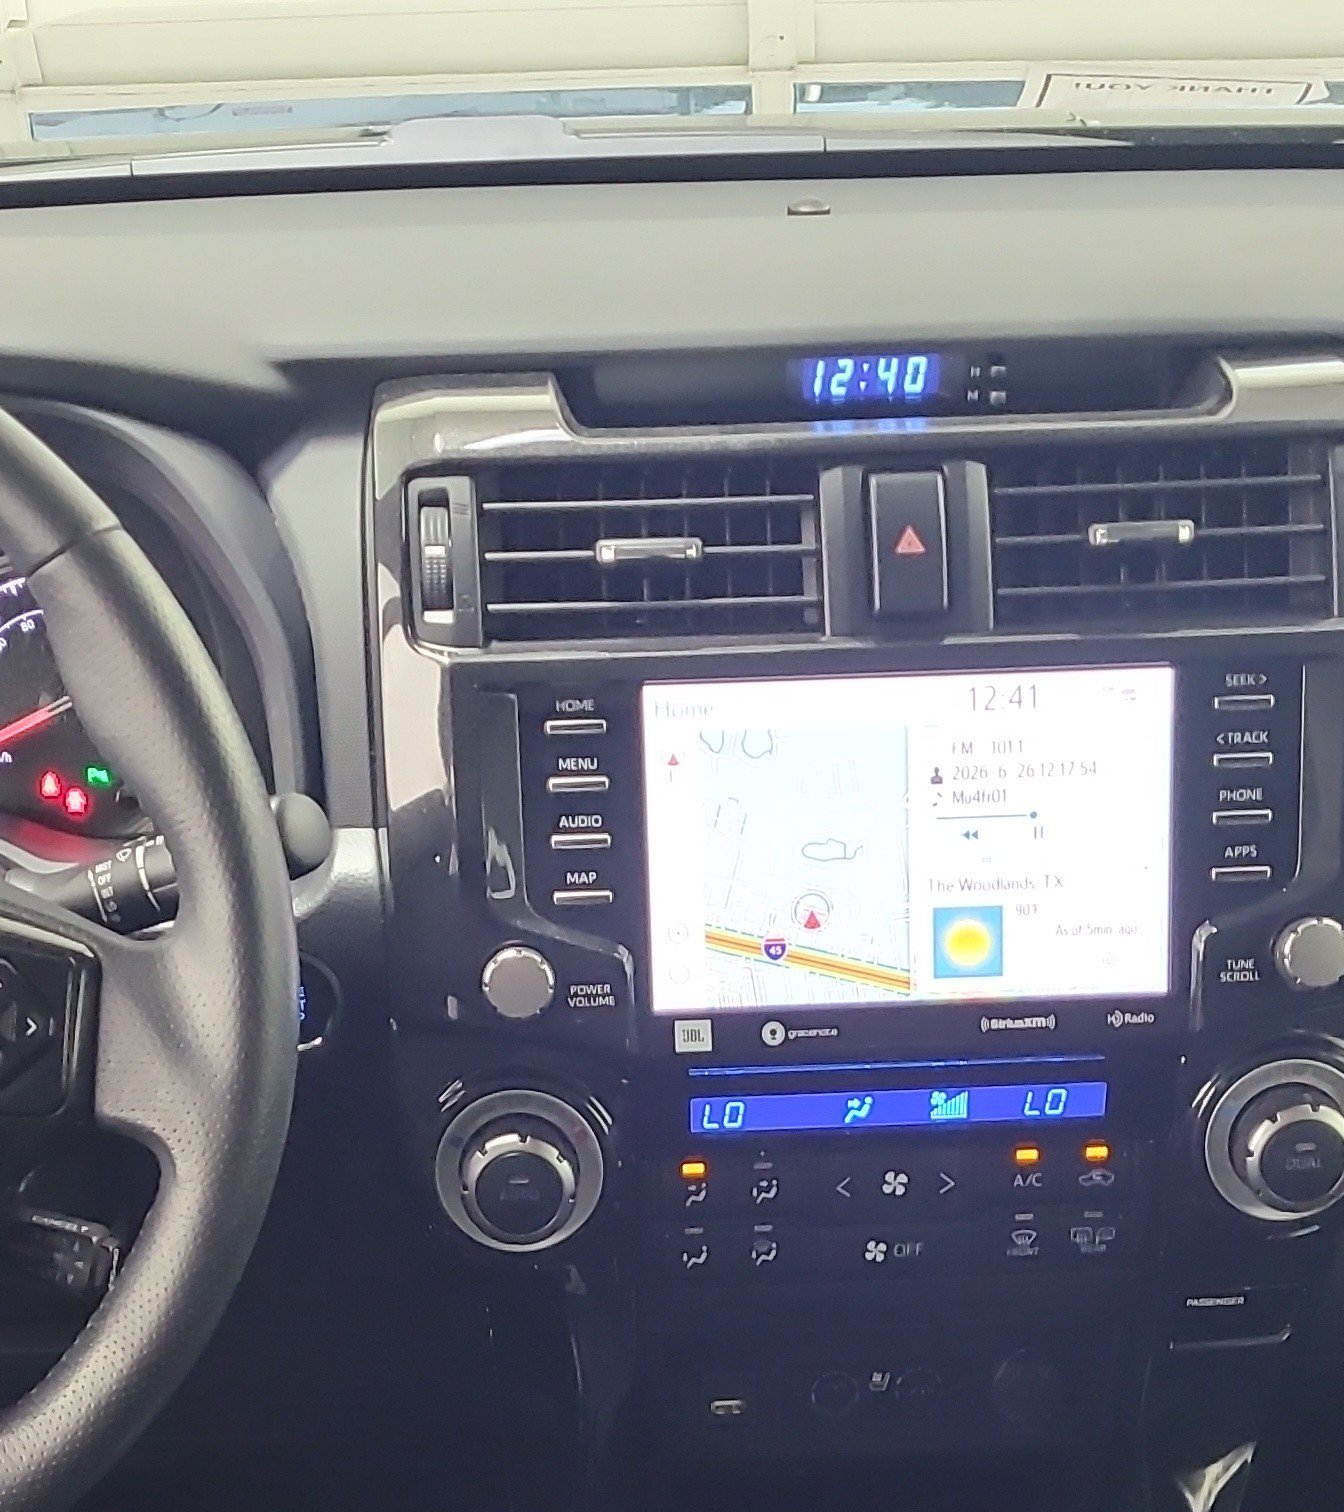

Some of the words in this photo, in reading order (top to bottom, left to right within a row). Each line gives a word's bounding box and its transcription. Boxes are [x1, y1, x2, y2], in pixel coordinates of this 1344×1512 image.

[813, 356, 928, 397] 12:40
[20, 619, 36, 633] 80
[1225, 673, 1256, 687] SEEK
[968, 684, 1038, 711] 12:41
[555, 699, 595, 713] HOME
[1227, 730, 1270, 745] TRACK
[952, 740, 974, 755] FM
[558, 757, 598, 771] MENU
[1219, 788, 1263, 802] PHONE
[559, 815, 603, 828] AUDIO
[1224, 845, 1258, 859] APPS
[566, 871, 597, 885] MAP
[927, 878, 955, 892] The
[1044, 874, 1065, 889] TX
[768, 945, 783, 956] 45
[1226, 958, 1256, 970] TUNE
[1219, 969, 1261, 983] SCROLL
[570, 983, 611, 996] POWER
[567, 995, 616, 1007] VOLUME
[1124, 1011, 1155, 1024] Radio
[682, 1028, 706, 1043] JBL
[1023, 1087, 1068, 1117] LO
[702, 1100, 746, 1130] LO
[1013, 1172, 1043, 1188] A/C
[893, 1242, 923, 1257] OFF
